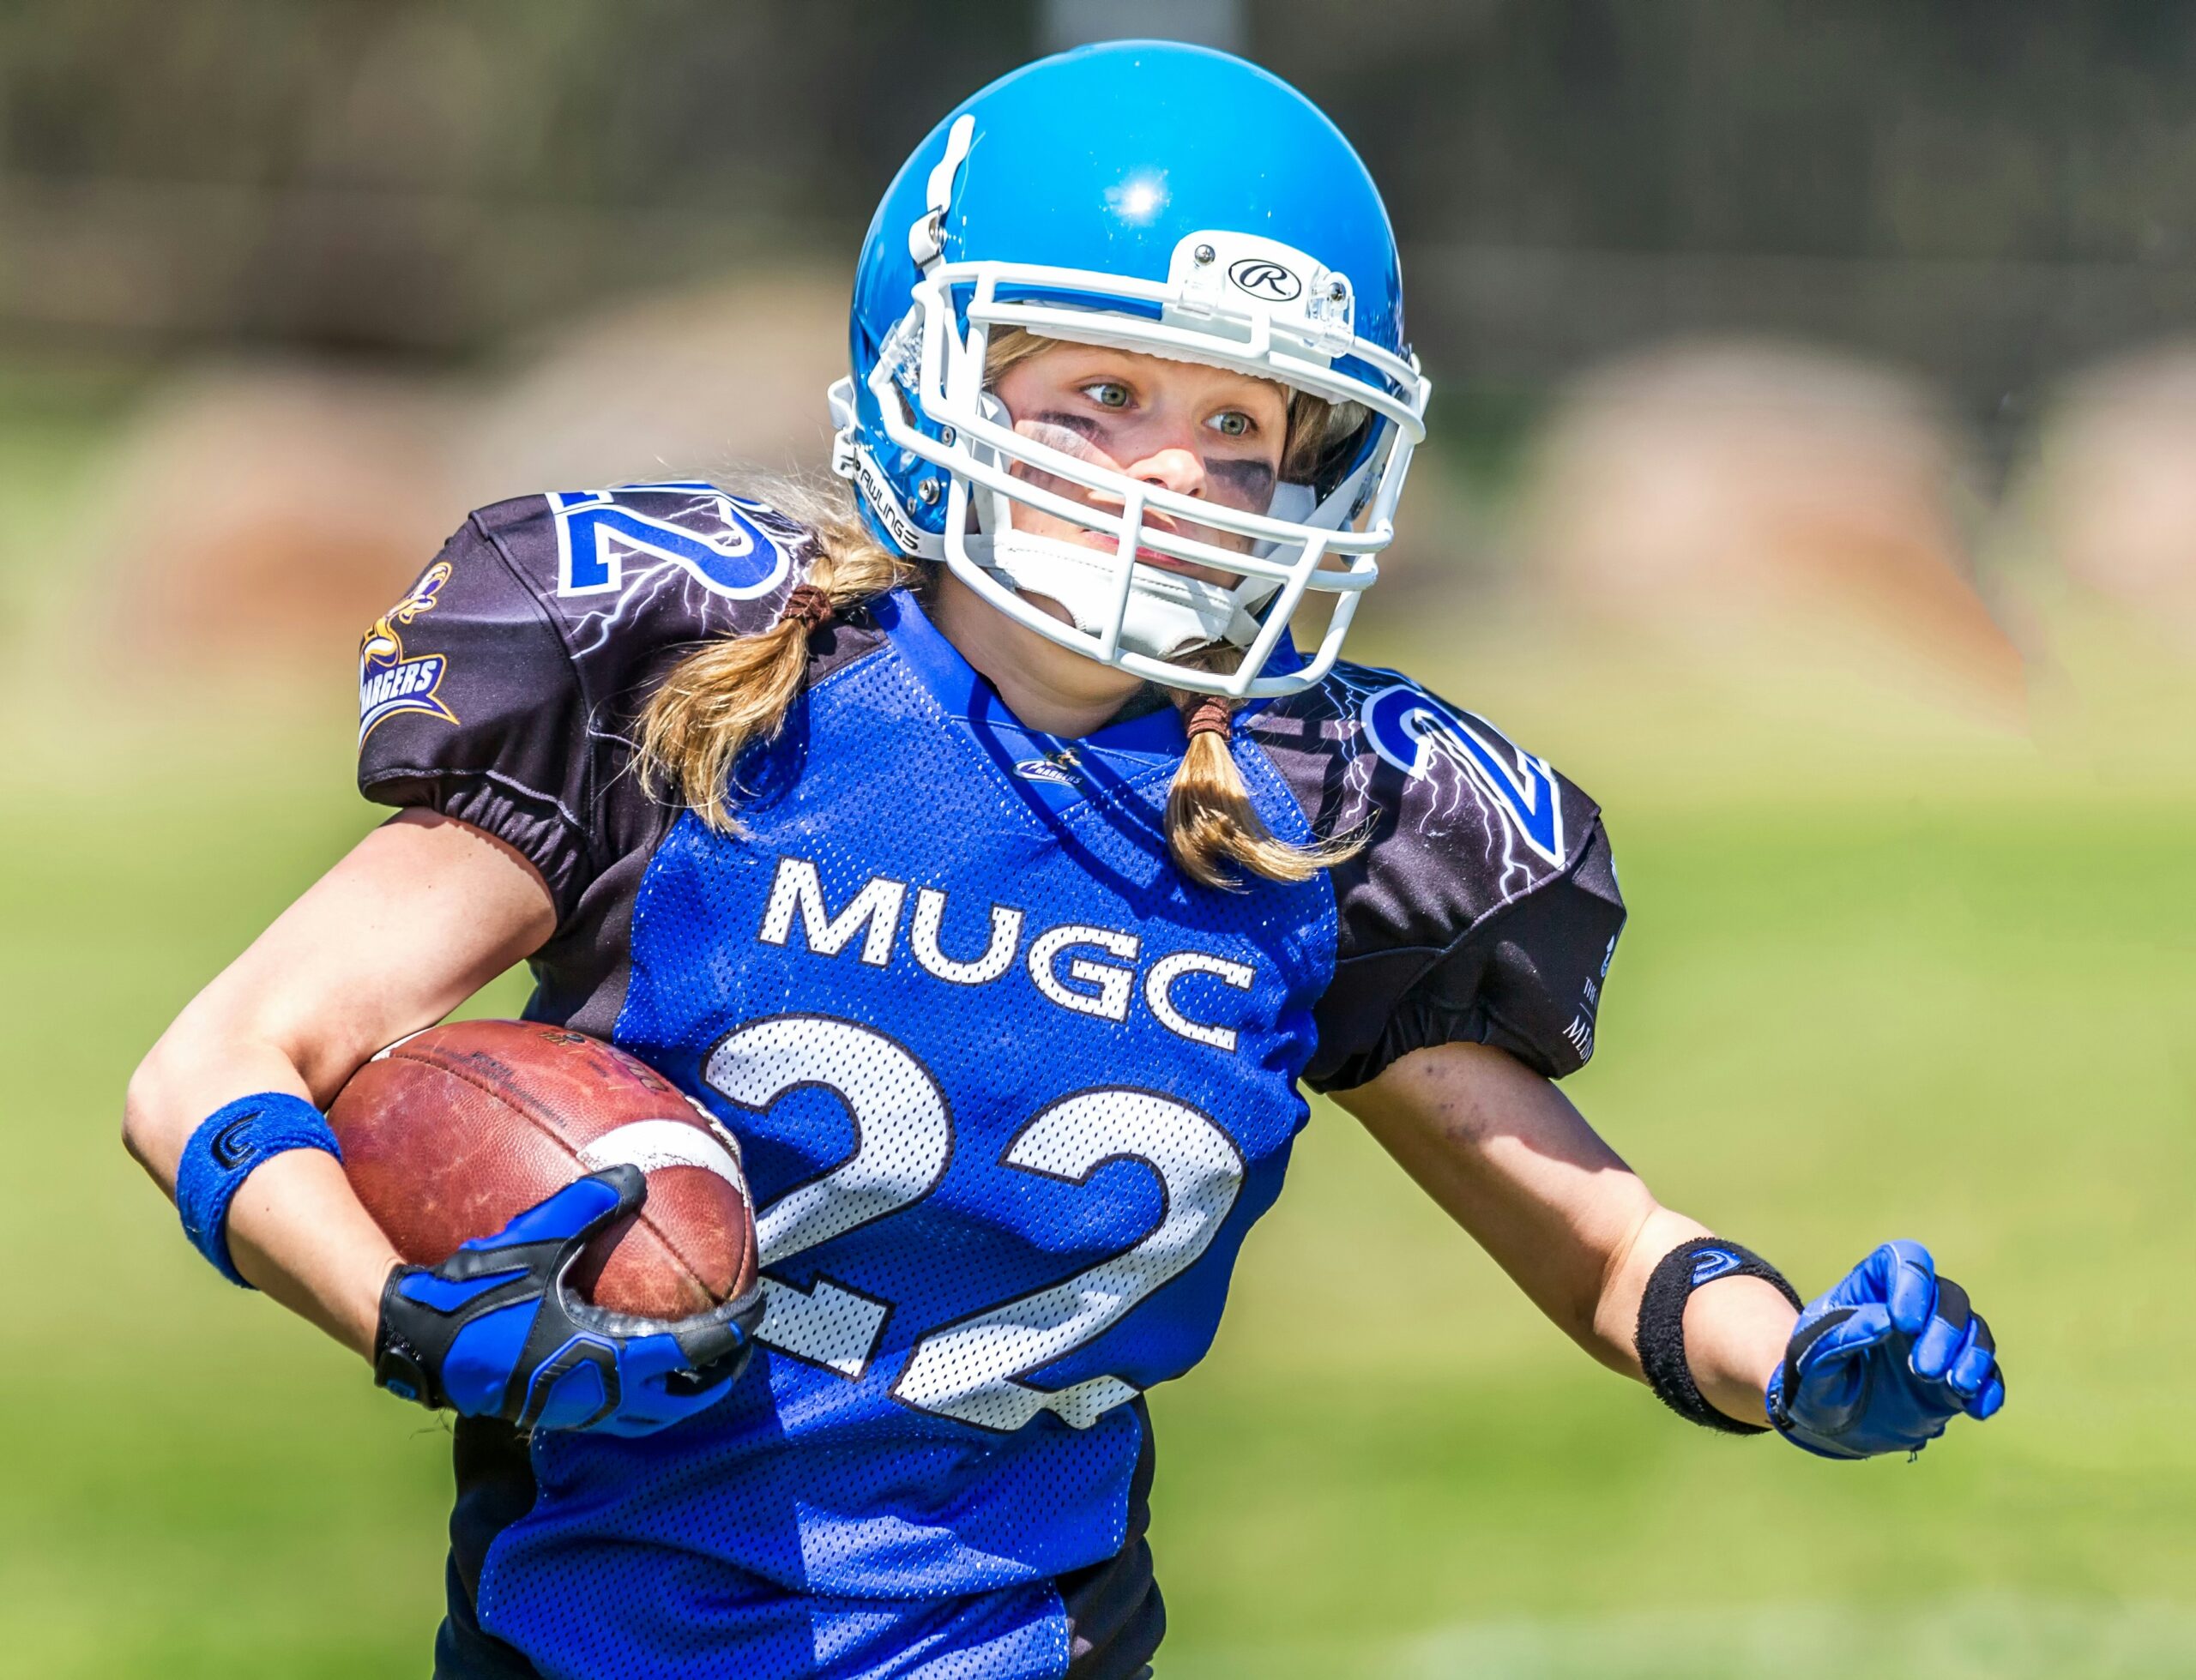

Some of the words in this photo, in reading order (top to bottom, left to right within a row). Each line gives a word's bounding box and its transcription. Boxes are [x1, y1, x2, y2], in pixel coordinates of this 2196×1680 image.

[840, 452, 920, 551] RAWLINGS
[758, 856, 1258, 1053] MUGC
[698, 1011, 1248, 1435] 22
